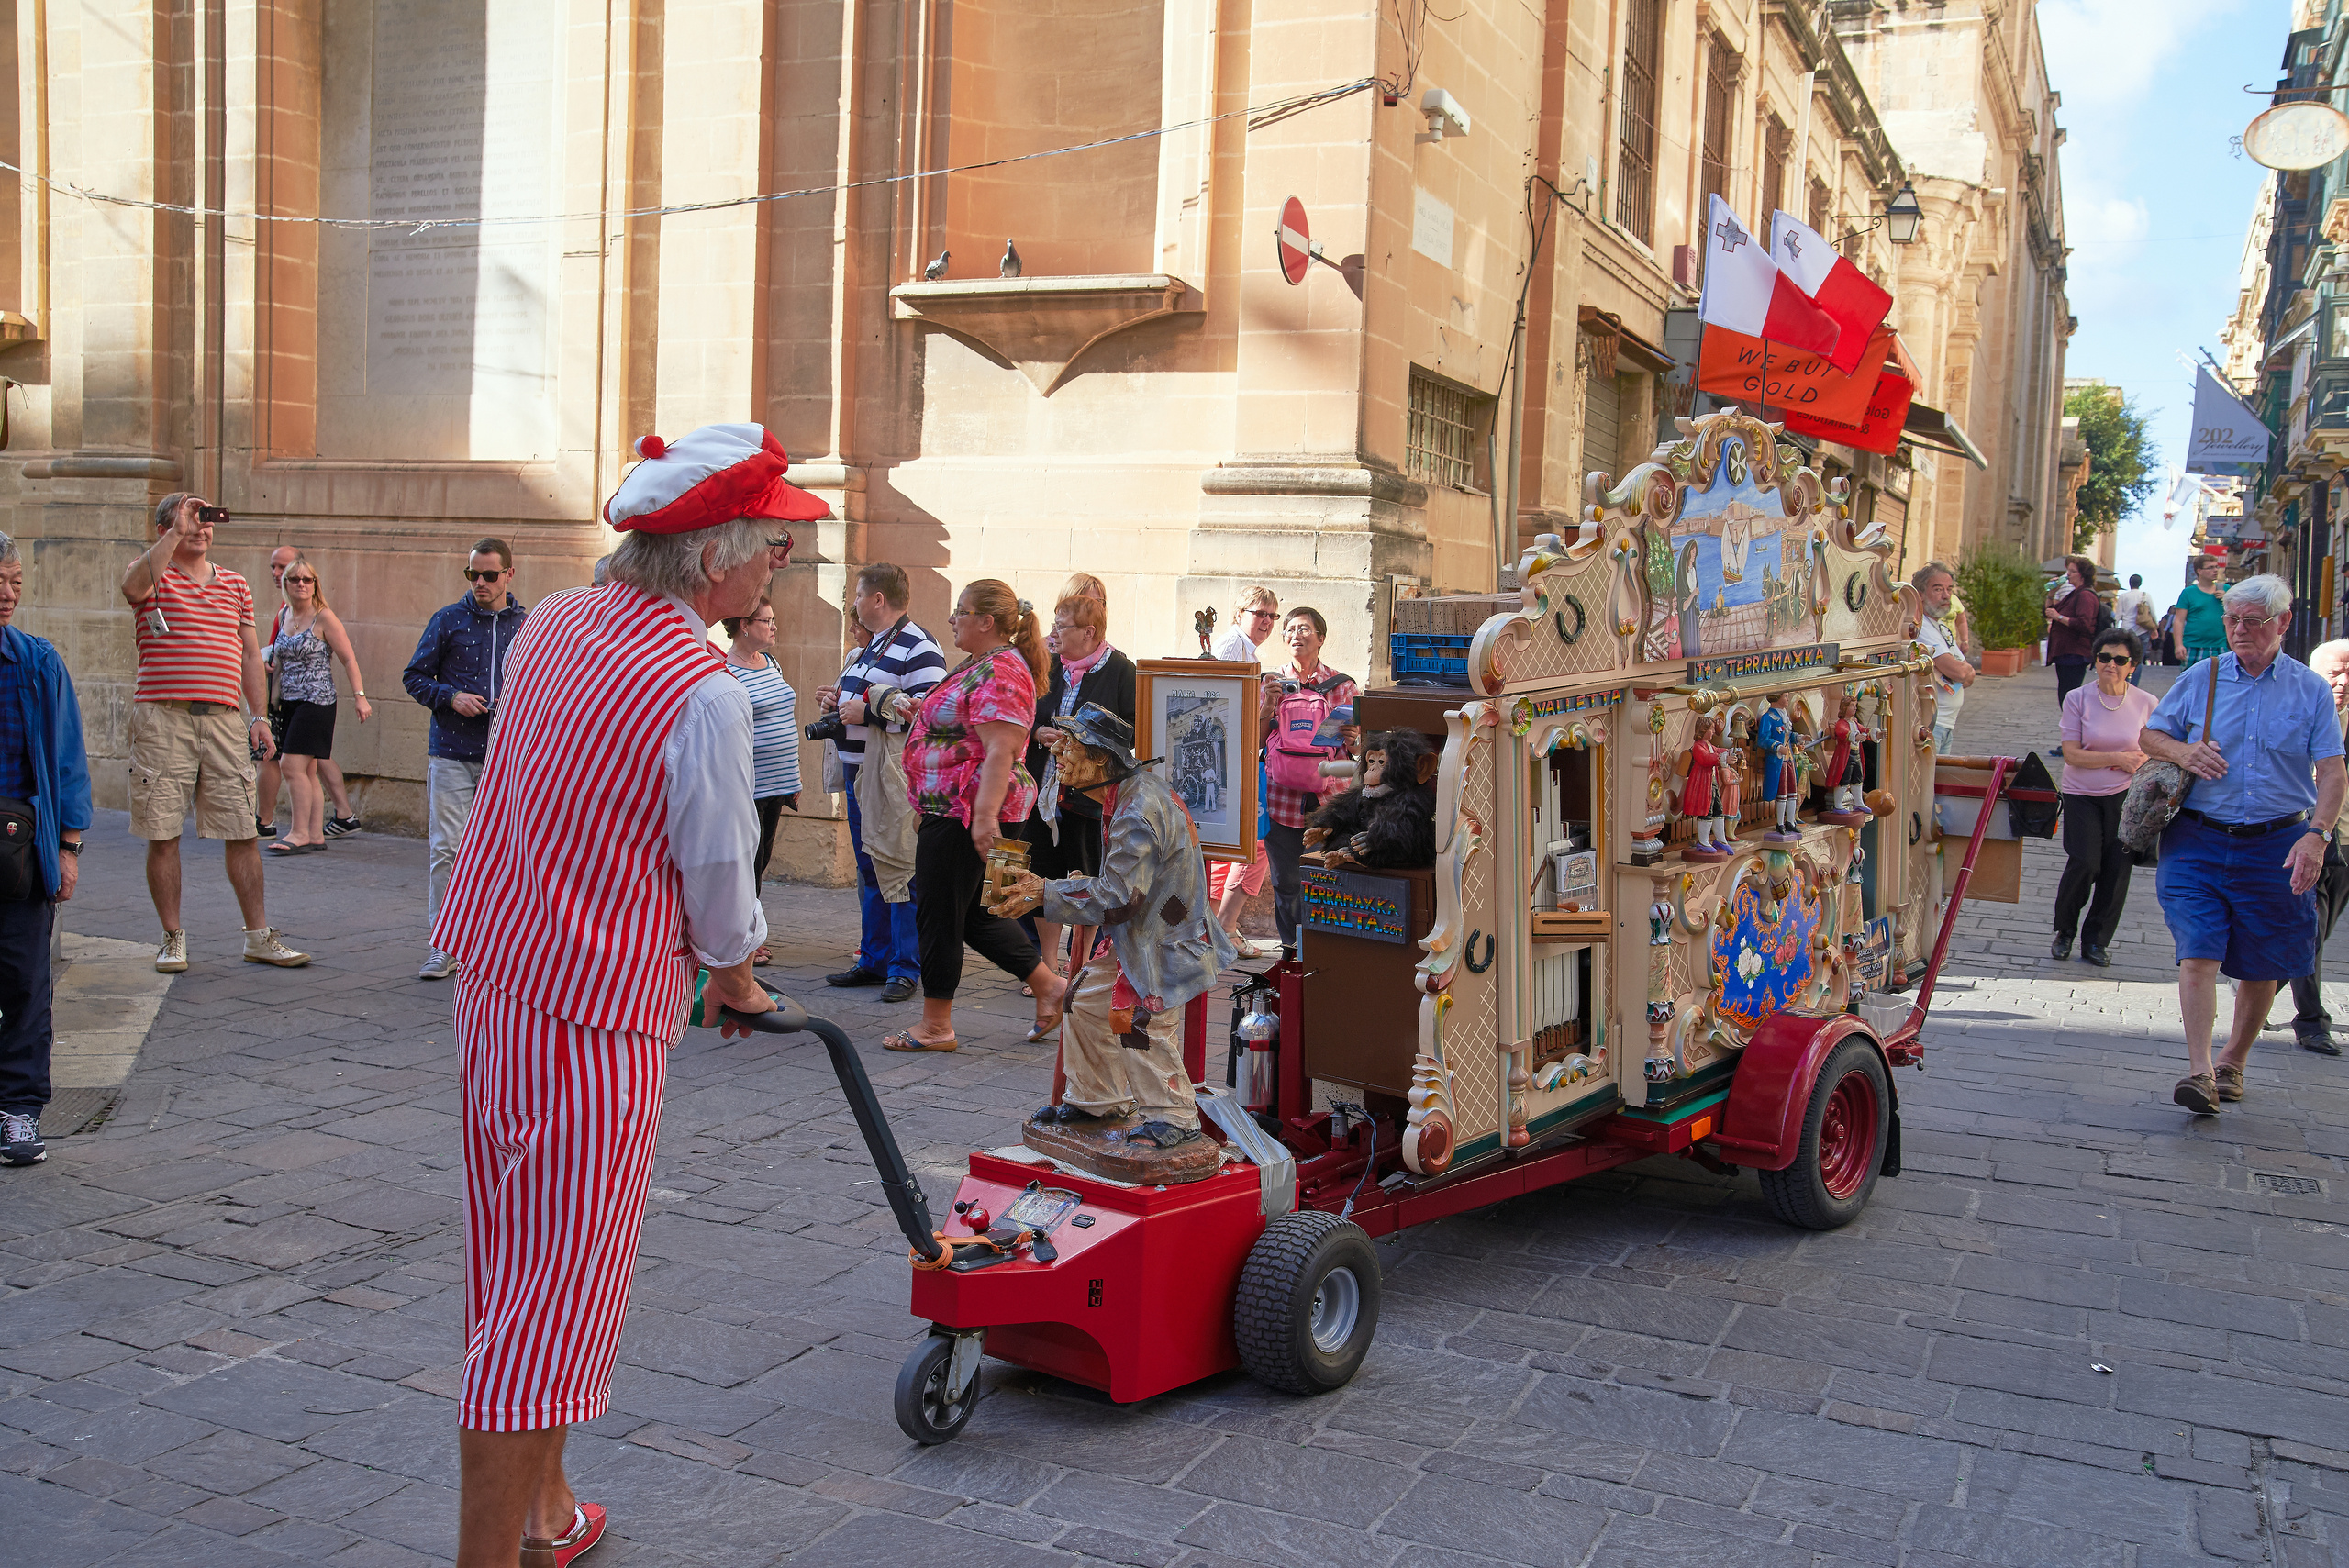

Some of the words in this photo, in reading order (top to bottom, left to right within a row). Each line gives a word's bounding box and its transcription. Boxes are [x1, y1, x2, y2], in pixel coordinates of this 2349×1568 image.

[1737, 346, 1778, 371] WE
[1784, 359, 1835, 378] BUY
[1743, 375, 1819, 404] GOLD
[2197, 428, 2234, 444] 202
[1726, 647, 1824, 678] TERRAMAXKA
[1534, 689, 1622, 717] VALLETTA
[1300, 880, 1400, 917] TERRAMAXKA
